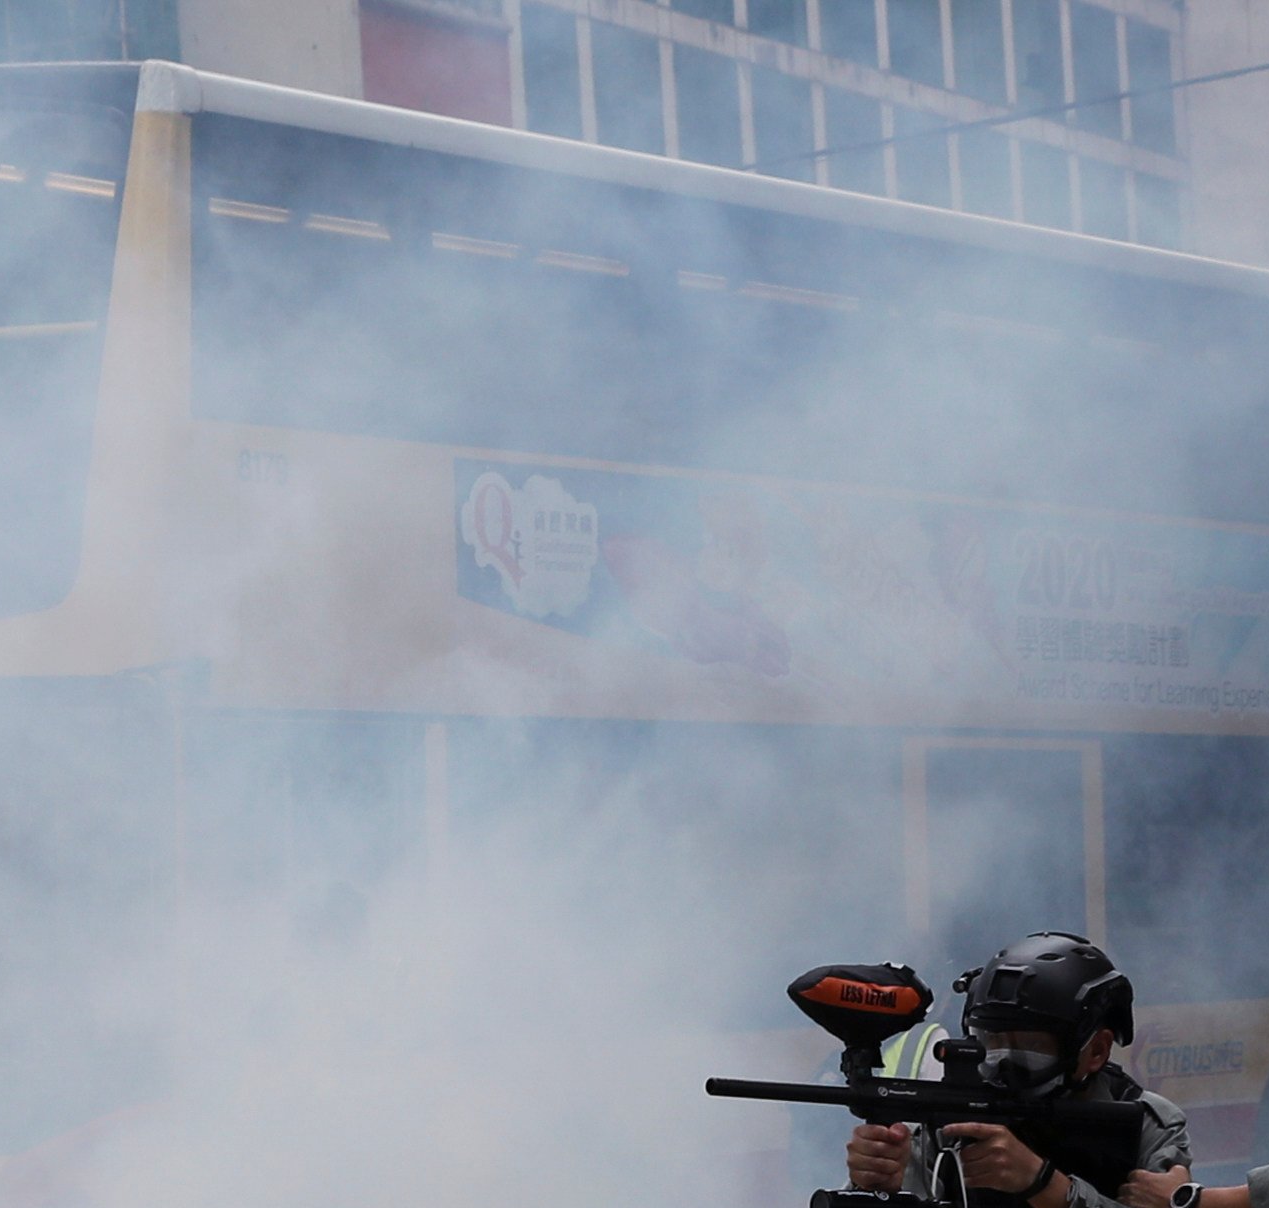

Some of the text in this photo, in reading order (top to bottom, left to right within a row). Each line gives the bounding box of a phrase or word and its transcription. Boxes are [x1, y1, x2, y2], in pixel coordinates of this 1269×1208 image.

[1013, 530, 1118, 611] 2020
[1016, 672, 1067, 699] Award
[1133, 676, 1154, 702] for
[1157, 677, 1221, 714] Learning
[840, 985, 898, 1009] LESS LETHAL
